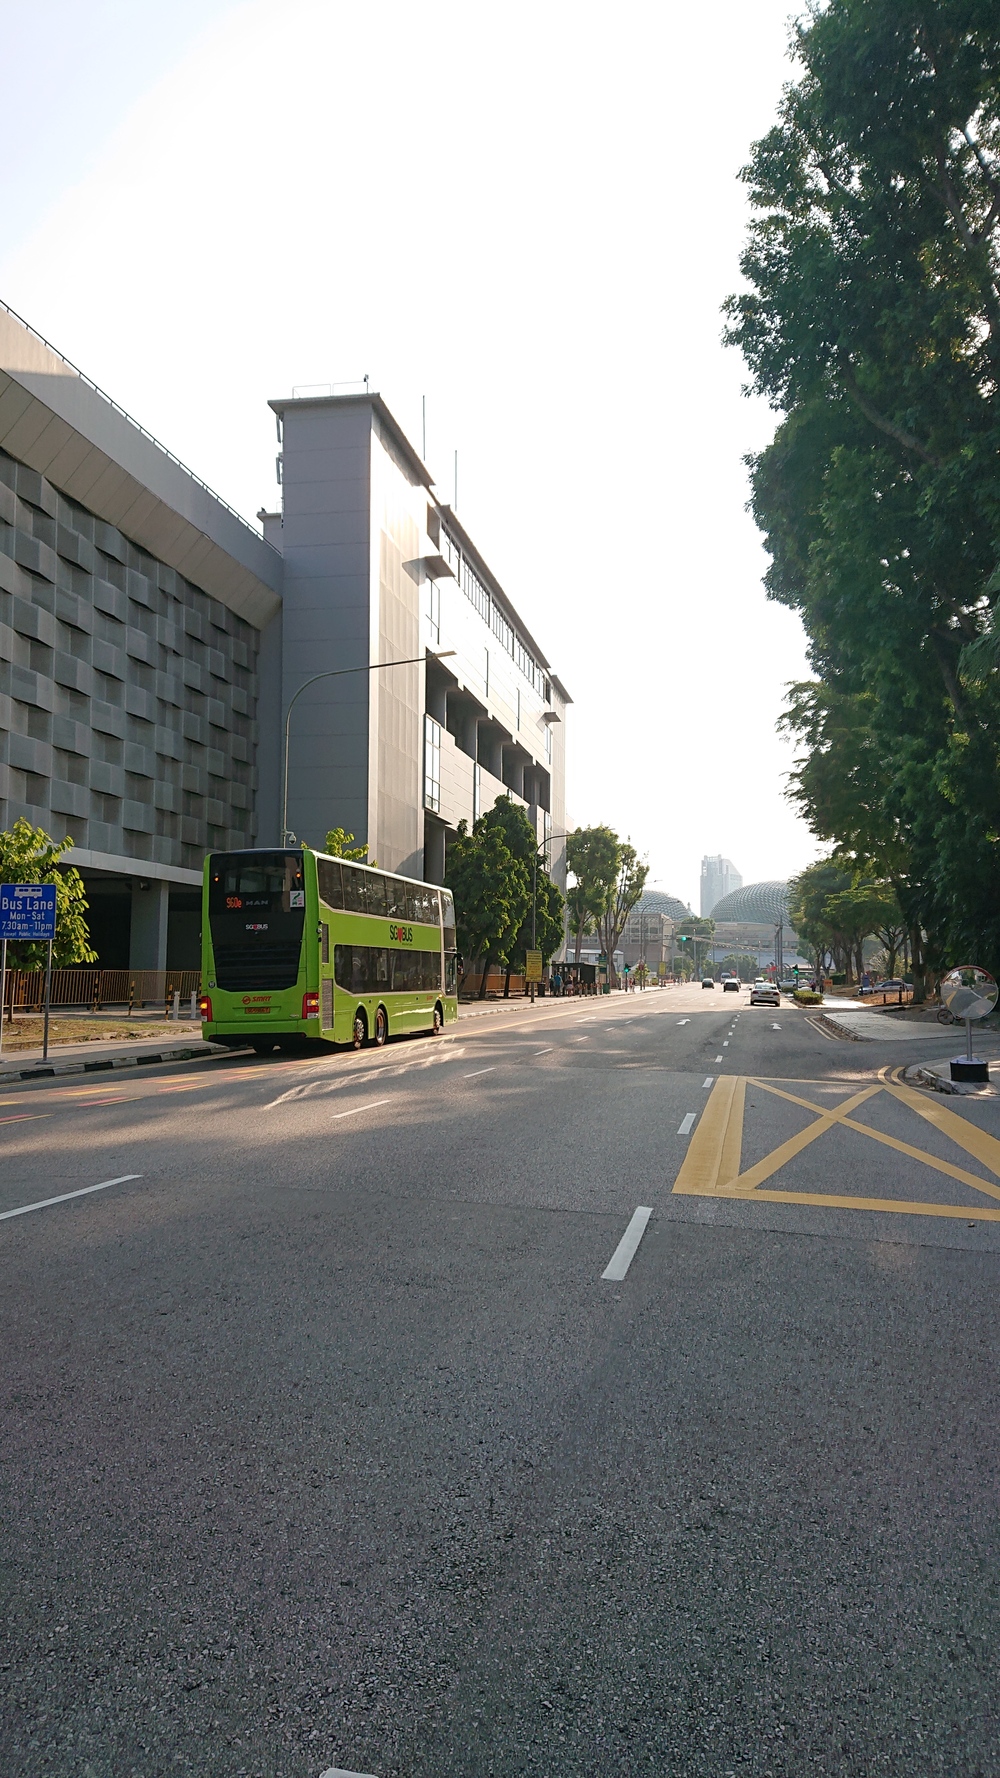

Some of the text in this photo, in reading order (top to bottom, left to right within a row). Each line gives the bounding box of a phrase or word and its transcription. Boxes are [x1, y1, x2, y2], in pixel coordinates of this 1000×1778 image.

[2, 898, 53, 910] Bus Lane
[10, 912, 44, 920] Mon-Sat
